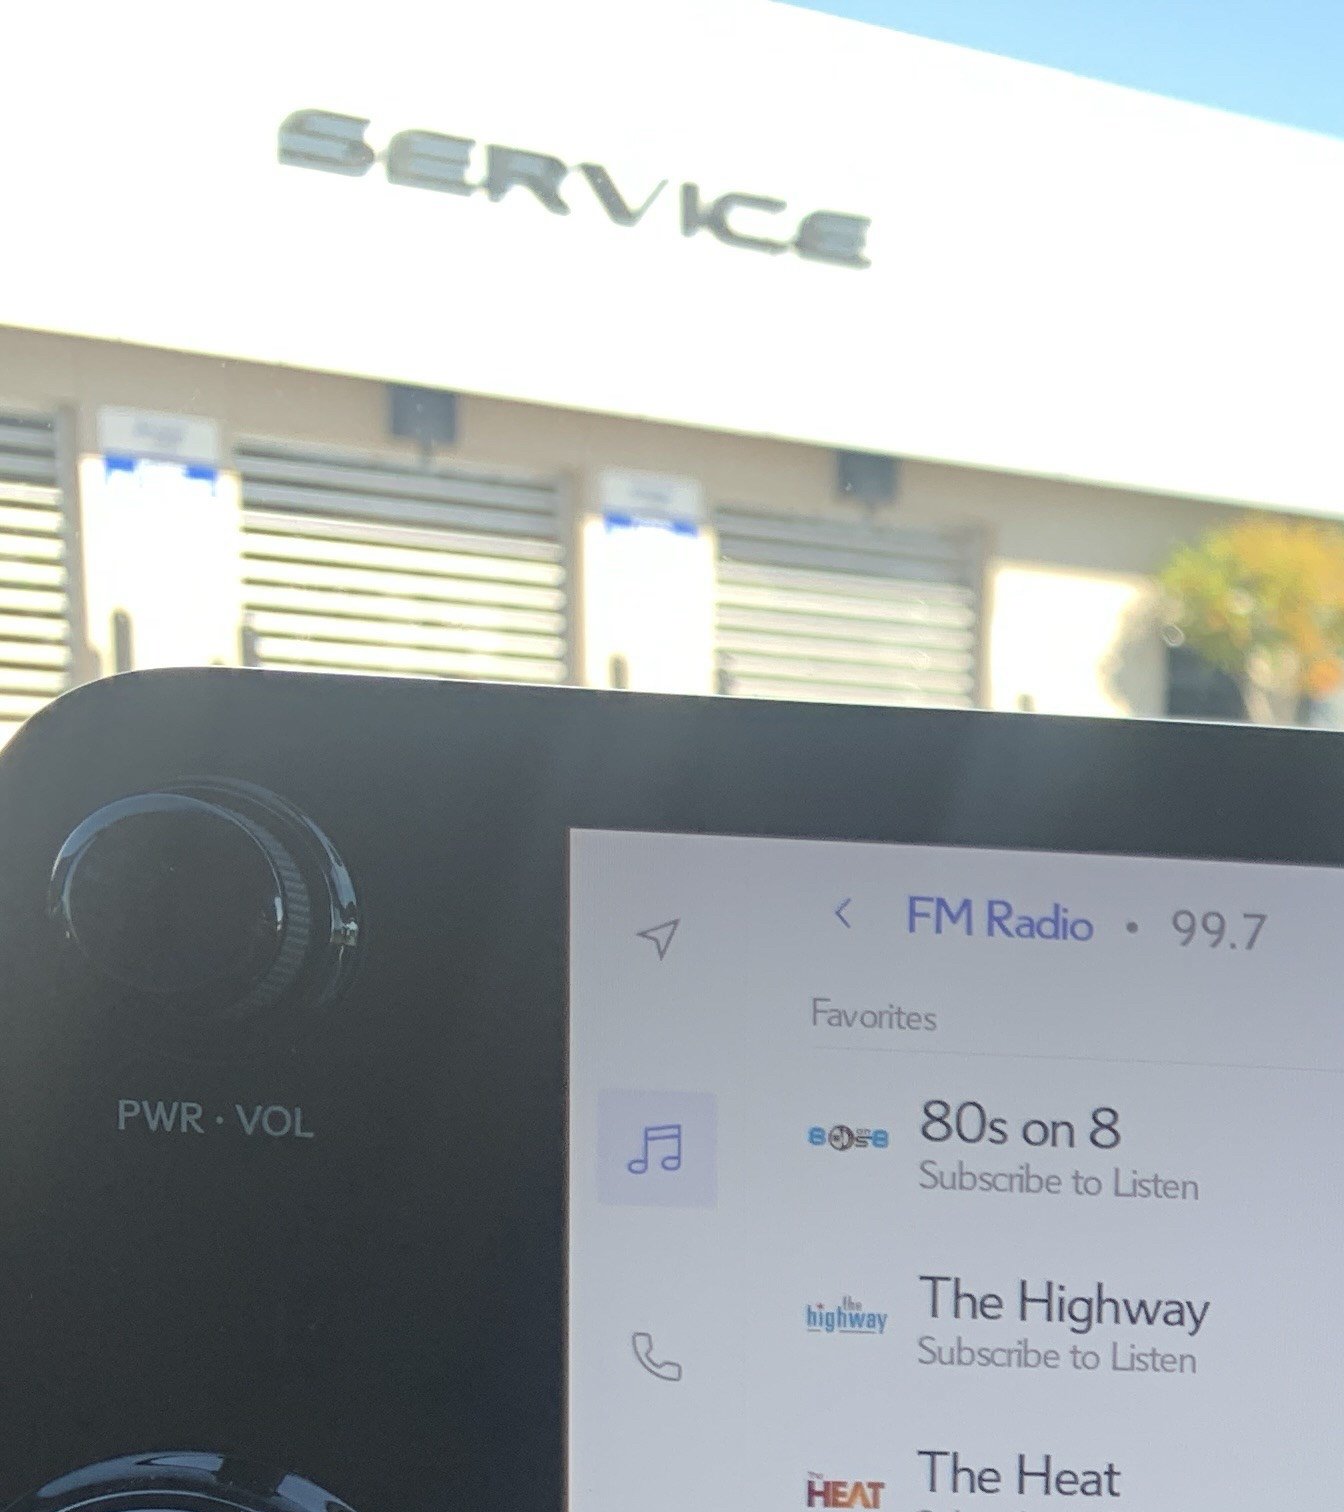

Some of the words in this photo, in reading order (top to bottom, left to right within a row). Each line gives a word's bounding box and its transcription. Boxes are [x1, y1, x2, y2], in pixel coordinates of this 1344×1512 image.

[279, 109, 871, 269] SERVICE
[909, 896, 972, 935] FM
[987, 900, 1093, 941] Radio
[1172, 910, 1267, 950] 99.7
[812, 997, 937, 1031] Favorites
[119, 1099, 204, 1133] PWR
[235, 1104, 314, 1138] VOL
[921, 1100, 1007, 1144] 80s
[1022, 1120, 1074, 1148] on
[1090, 1107, 1120, 1149] 8
[919, 1160, 1062, 1194] Subscribe
[1071, 1170, 1102, 1196] to
[1114, 1167, 1198, 1200] Listen
[806, 1304, 888, 1334] highway
[919, 1275, 1003, 1320] The
[1020, 1280, 1210, 1336] Highway
[918, 1335, 1060, 1369] Subscribe
[1069, 1345, 1100, 1370] to
[1110, 1345, 1197, 1376] Listen
[917, 1450, 1001, 1494] The
[1018, 1454, 1121, 1497] Heat
[807, 1480, 886, 1509] HEAT
